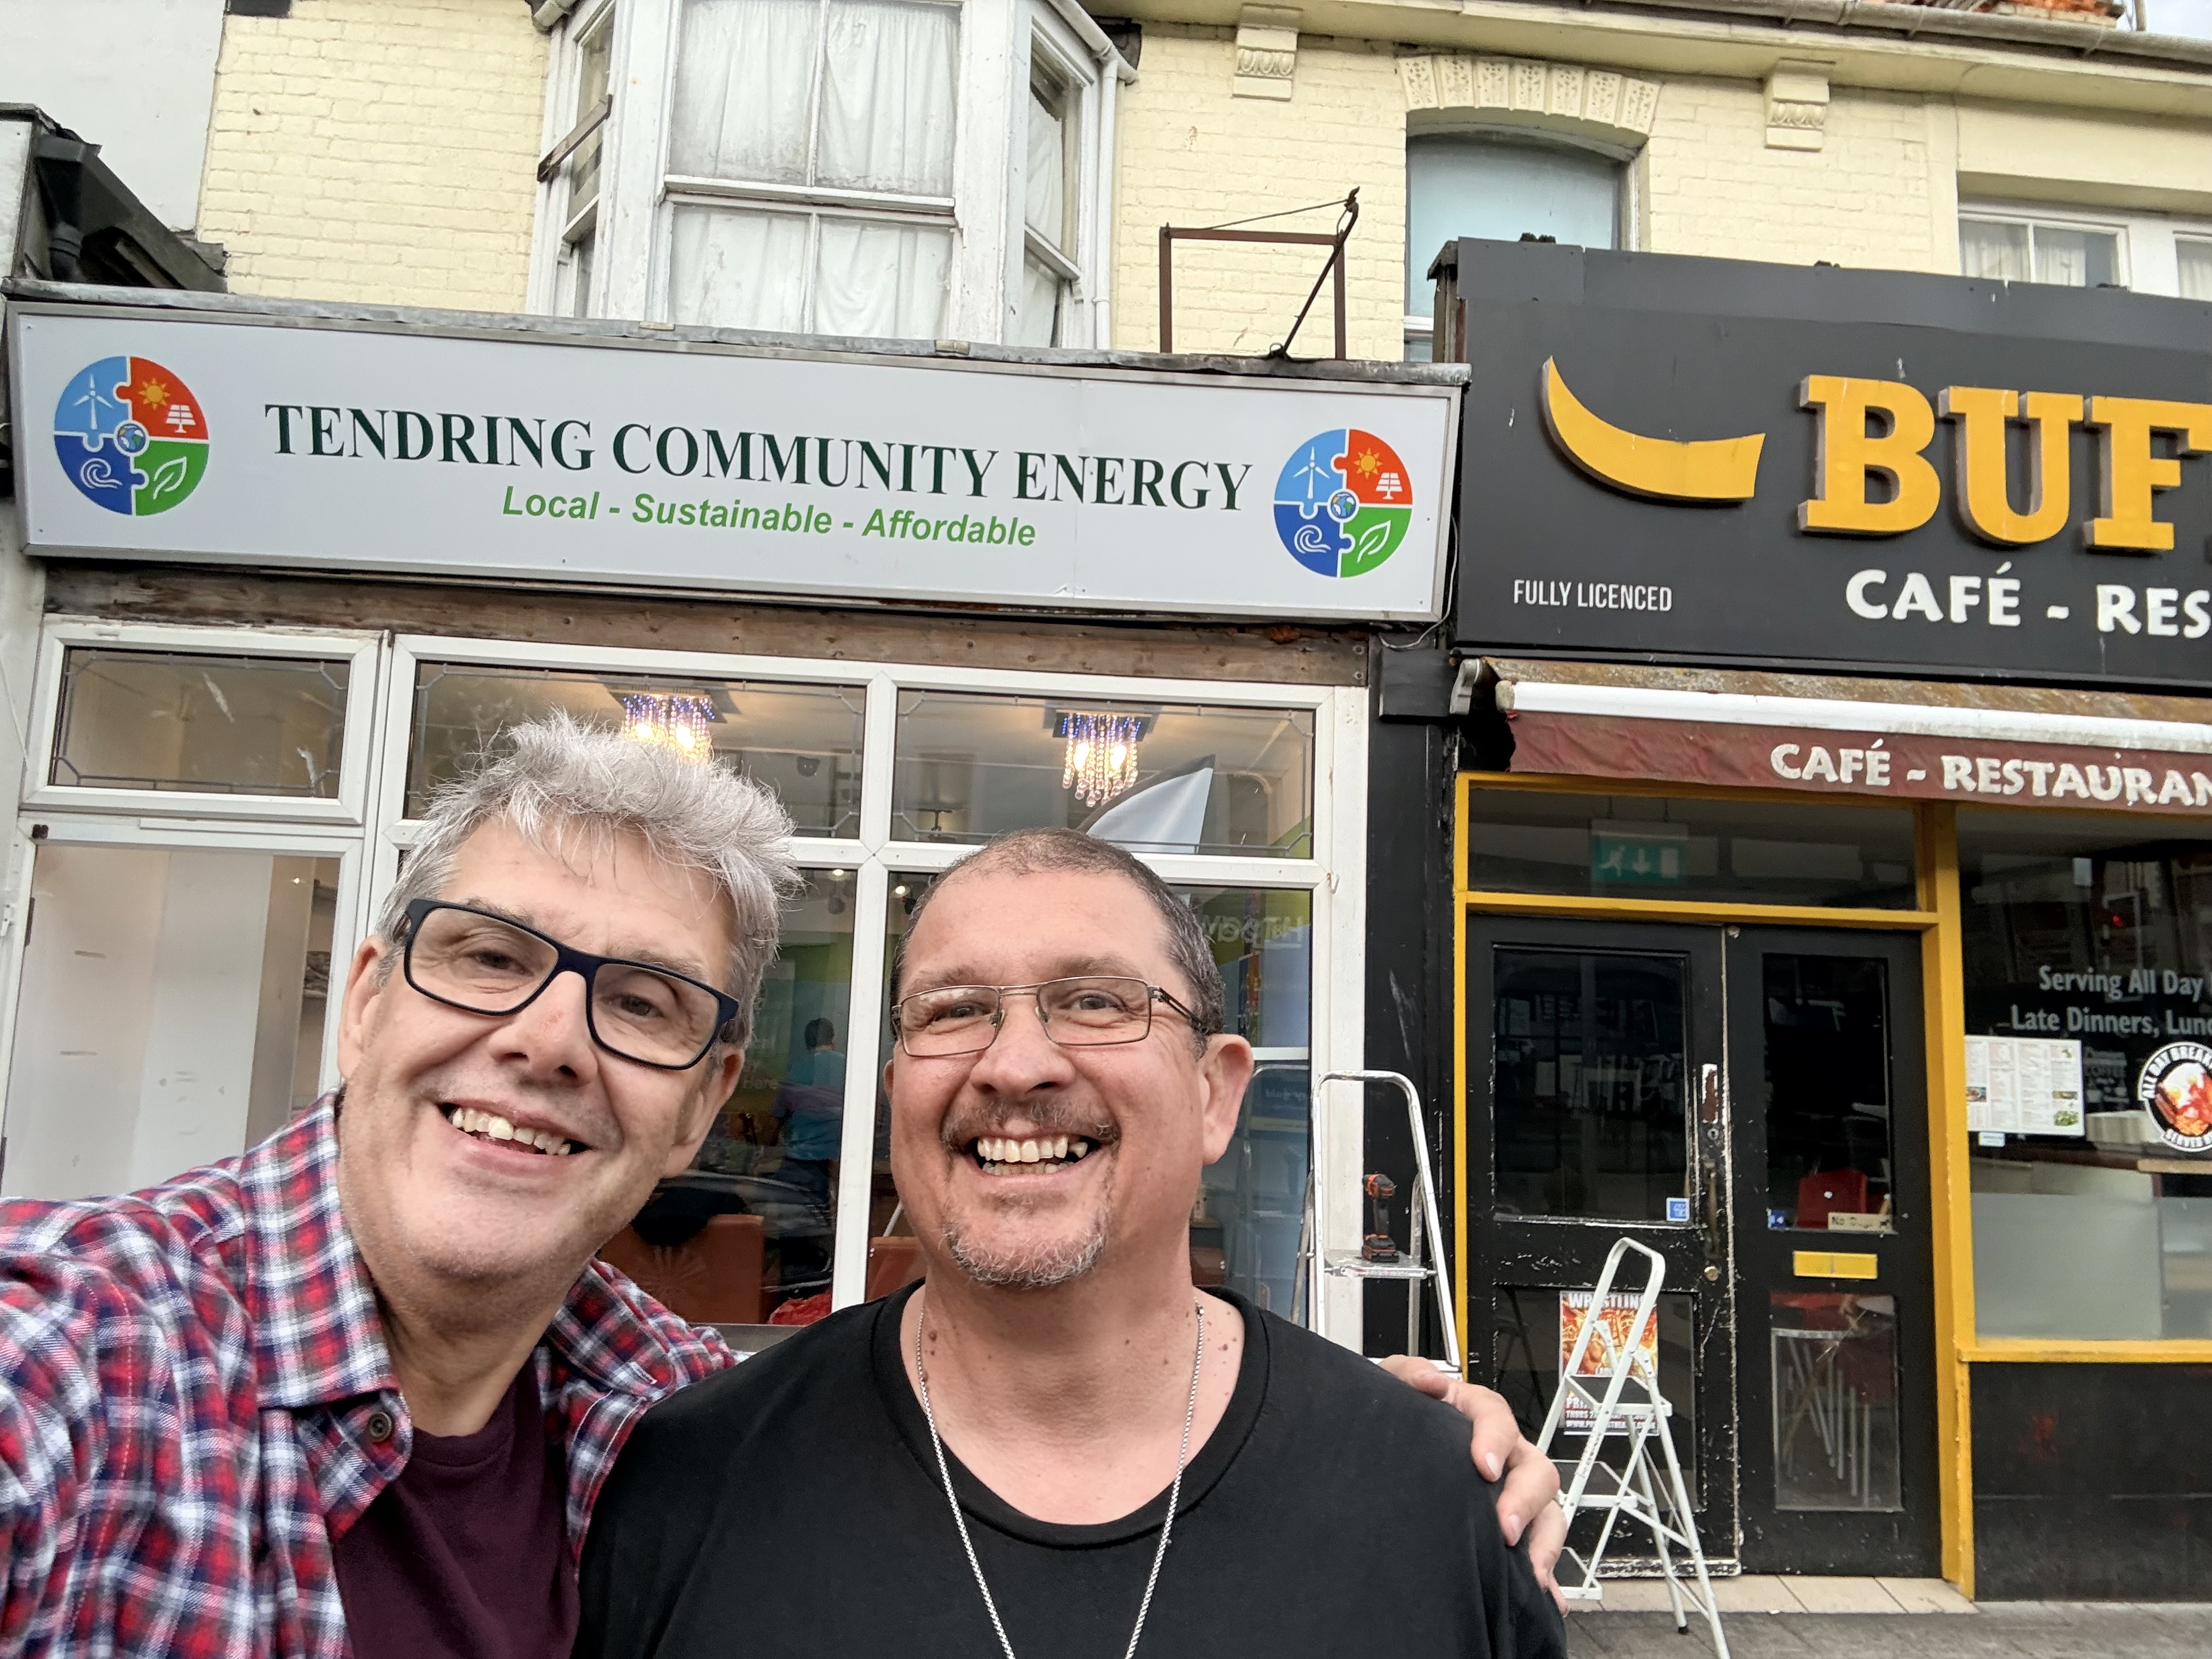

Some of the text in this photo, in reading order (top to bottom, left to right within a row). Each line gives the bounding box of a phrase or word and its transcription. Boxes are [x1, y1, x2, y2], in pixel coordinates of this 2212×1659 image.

[265, 404, 1255, 511] TENDRING COMMUNITY ENERGY
[1799, 375, 2212, 551] BUF
[503, 486, 600, 520] Local
[633, 494, 832, 534] Sustainable
[862, 509, 1036, 546] Affordable
[1513, 579, 1672, 611] FULLY LICENCED
[1846, 561, 2021, 626] CAFÉ
[2096, 585, 2211, 638] RES
[1770, 738, 1891, 786] CAFÉ
[2039, 964, 2204, 1003] Serving All Day
[2011, 1005, 2060, 1031] Late
[2067, 1006, 2160, 1038] Dinners,
[2148, 1050, 2171, 1076] DAY
[2142, 1075, 2158, 1098] ALL
